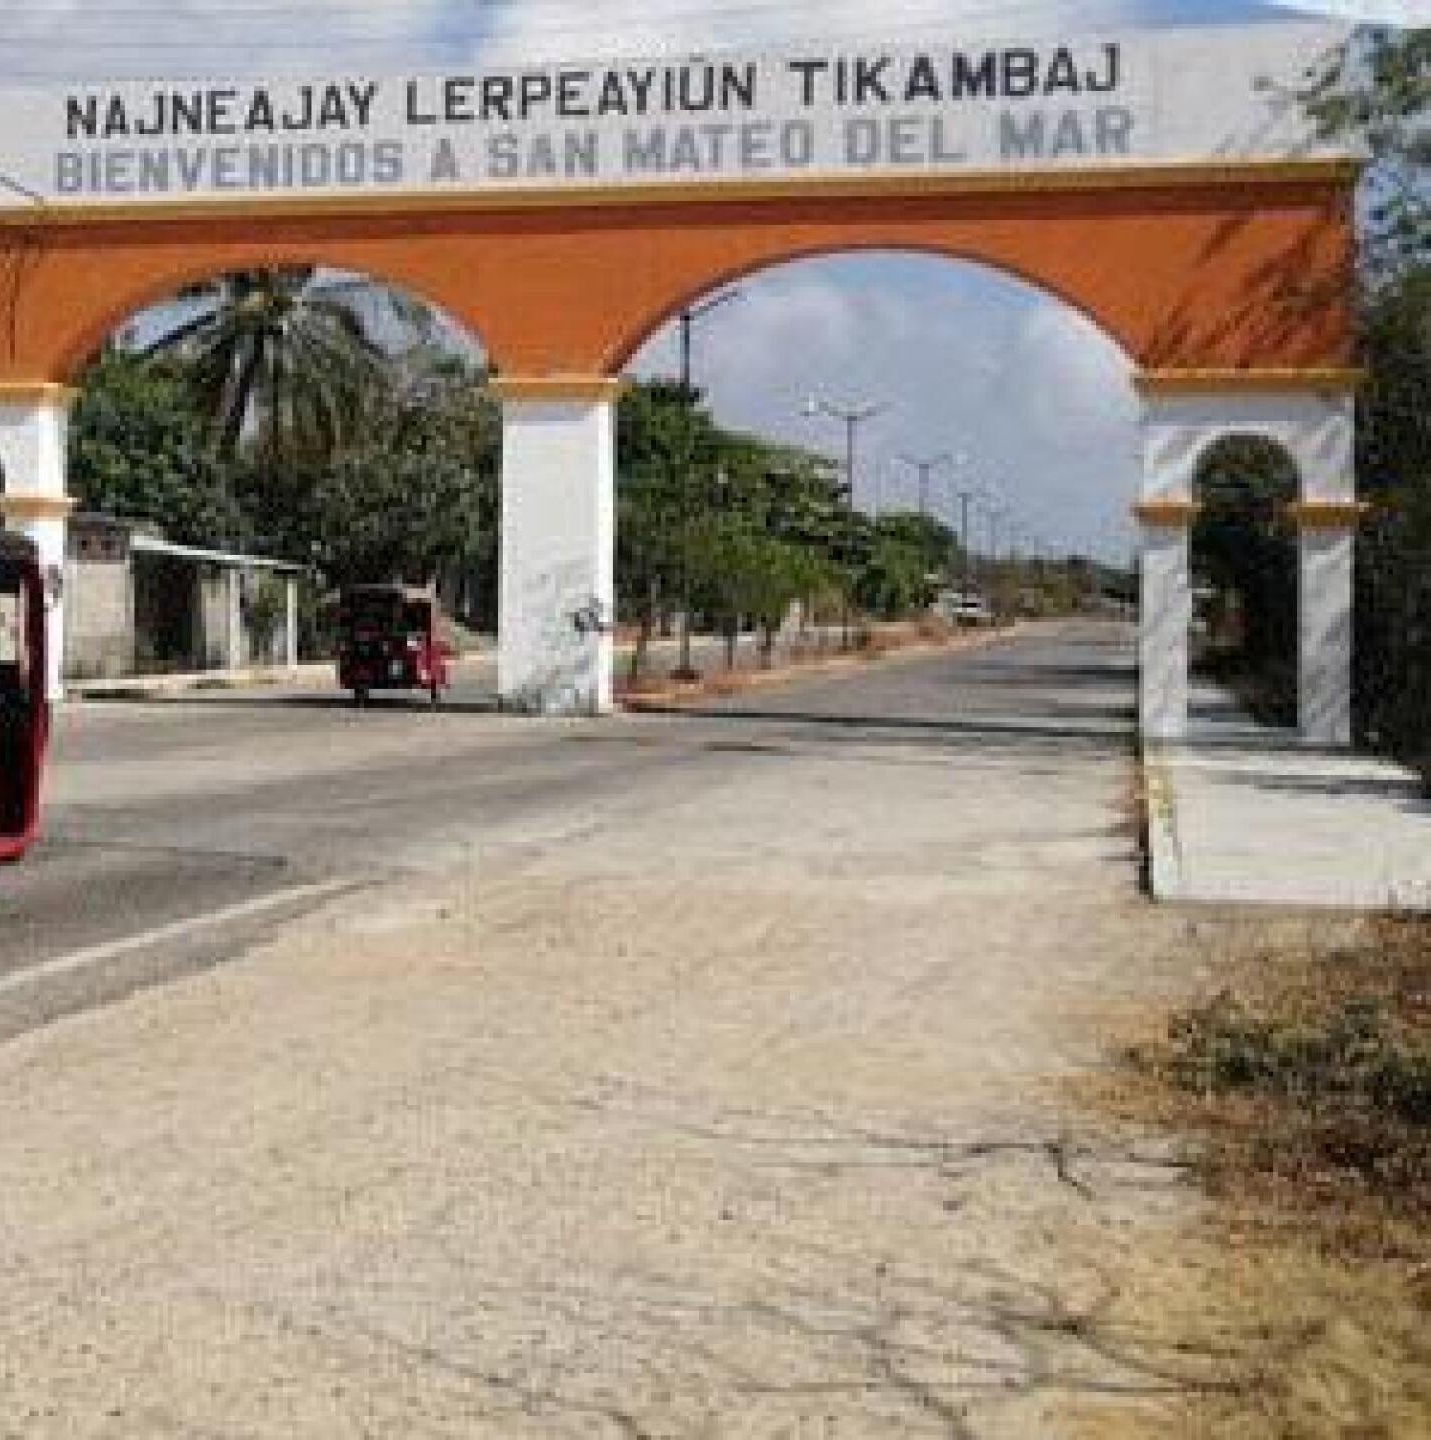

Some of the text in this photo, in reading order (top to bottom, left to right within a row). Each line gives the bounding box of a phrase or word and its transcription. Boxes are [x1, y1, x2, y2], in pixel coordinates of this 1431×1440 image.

[66, 83, 376, 138] NAJNEAJAY
[788, 43, 1121, 104] TIKAMBAJ
[55, 106, 1135, 193] BIENVENIDOS A SAN MATEO DEL MAR
